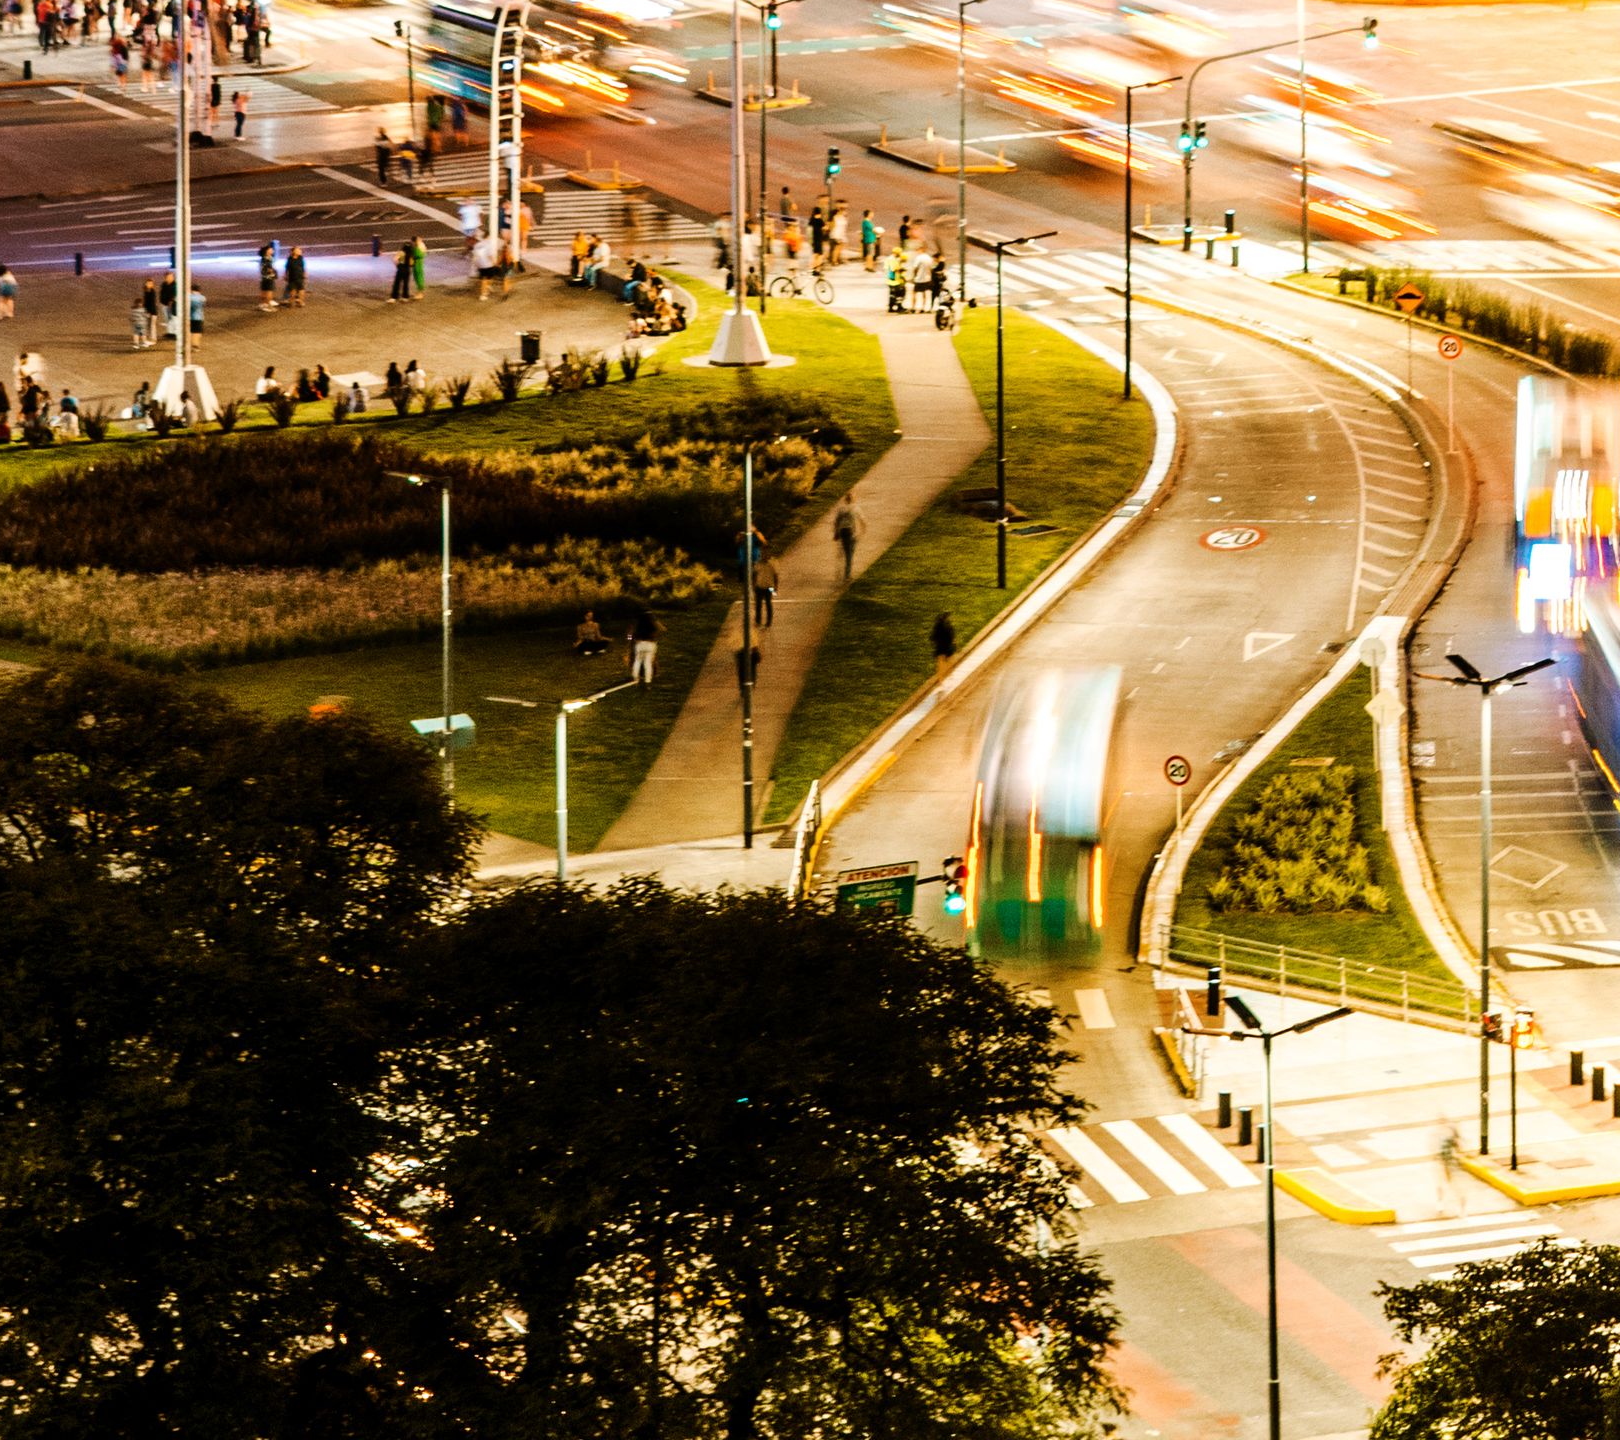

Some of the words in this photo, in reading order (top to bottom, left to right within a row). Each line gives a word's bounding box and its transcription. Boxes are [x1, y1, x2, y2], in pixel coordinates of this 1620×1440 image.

[1213, 530, 1256, 546] 20
[1170, 763, 1187, 778] 20
[846, 864, 910, 883] ATENCION
[1504, 907, 1608, 937] BUS
